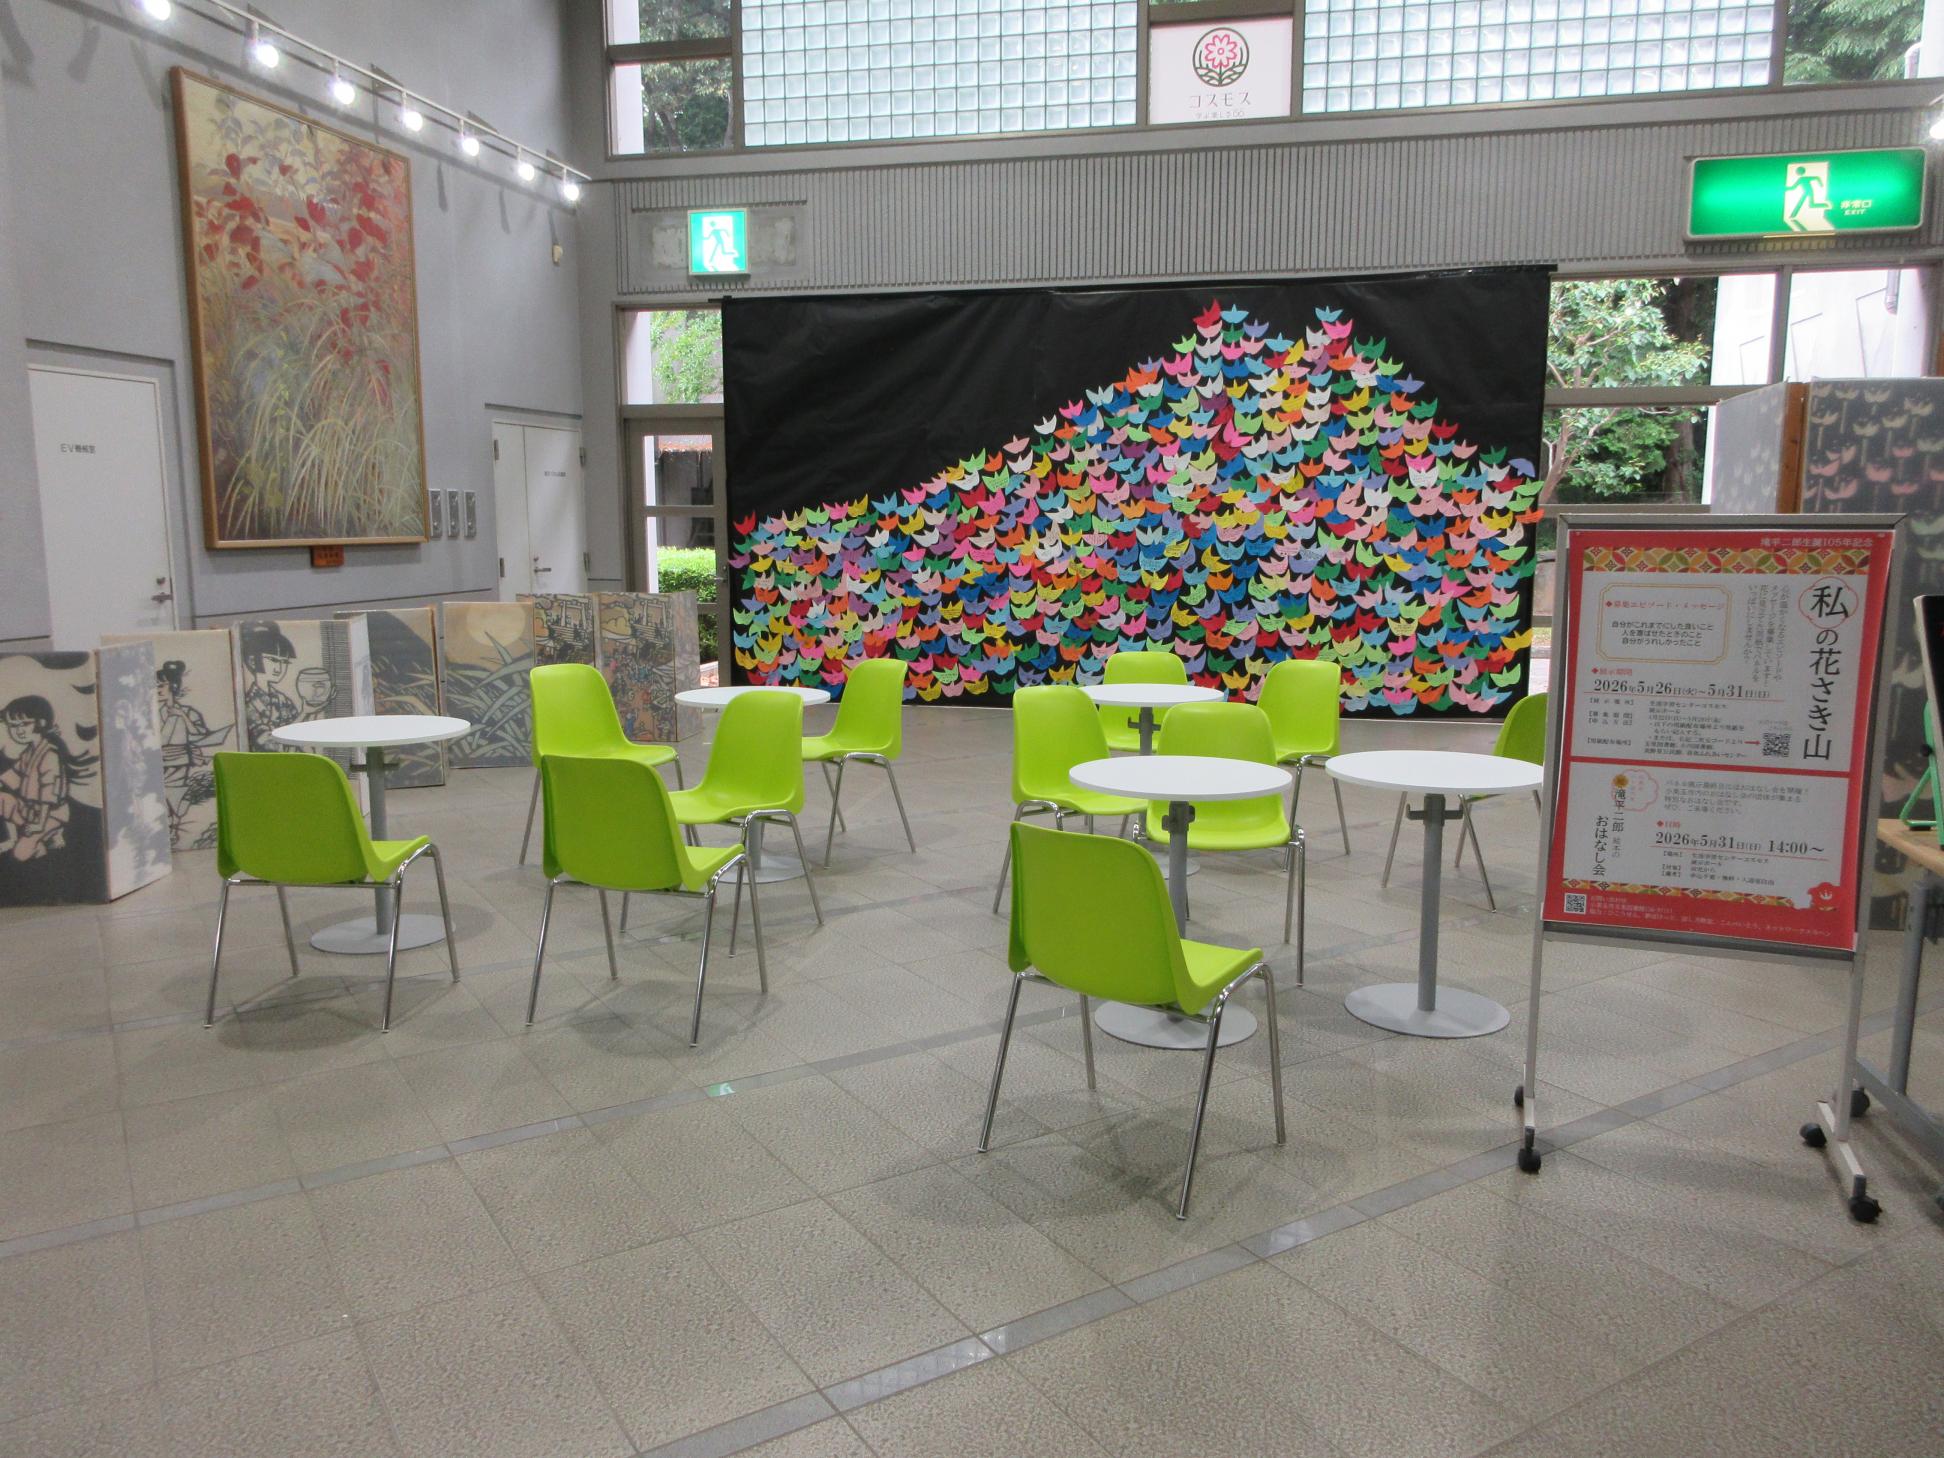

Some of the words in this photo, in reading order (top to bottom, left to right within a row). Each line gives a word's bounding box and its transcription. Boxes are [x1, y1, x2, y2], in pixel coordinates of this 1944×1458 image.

[1189, 92, 1251, 108] コスモス
[1841, 200, 1872, 209] 非常口
[1612, 620, 1714, 631] 自分がこれまでにした良いこと
[1621, 638, 1702, 647] 自分がうれしかったこと
[1803, 585, 1849, 760] 私の花さき山
[1593, 816, 1609, 876] おはなし会
